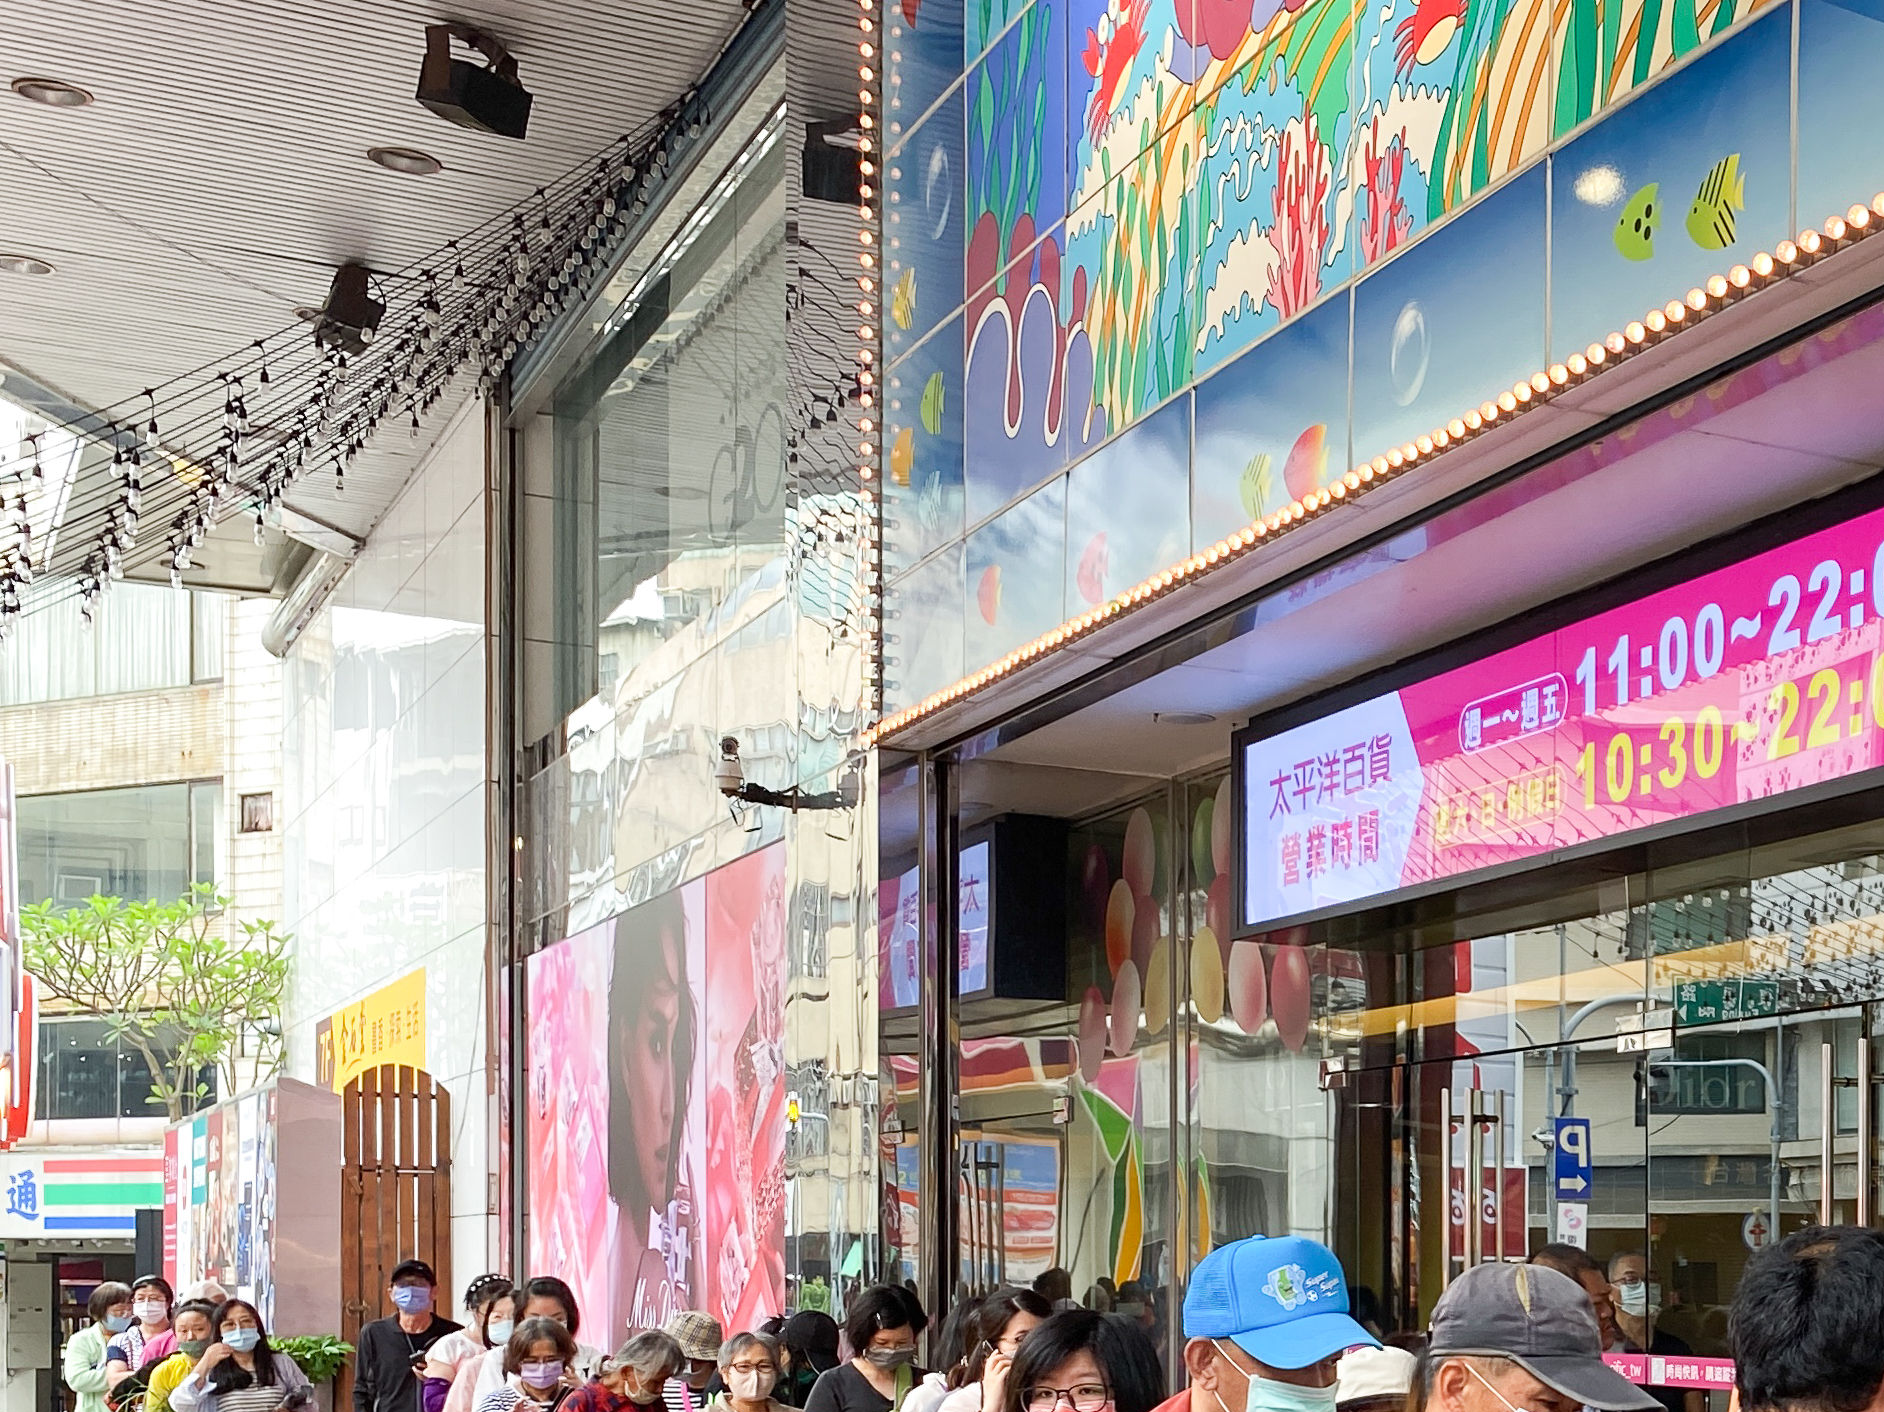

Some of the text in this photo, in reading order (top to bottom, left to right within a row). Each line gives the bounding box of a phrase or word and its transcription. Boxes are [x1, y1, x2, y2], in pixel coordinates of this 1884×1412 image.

[1269, 732, 1393, 820] 太平洋百貨
[1281, 809, 1380, 888] 營業時間
[7, 1169, 39, 1221] 通
[627, 1278, 657, 1329] Miss
